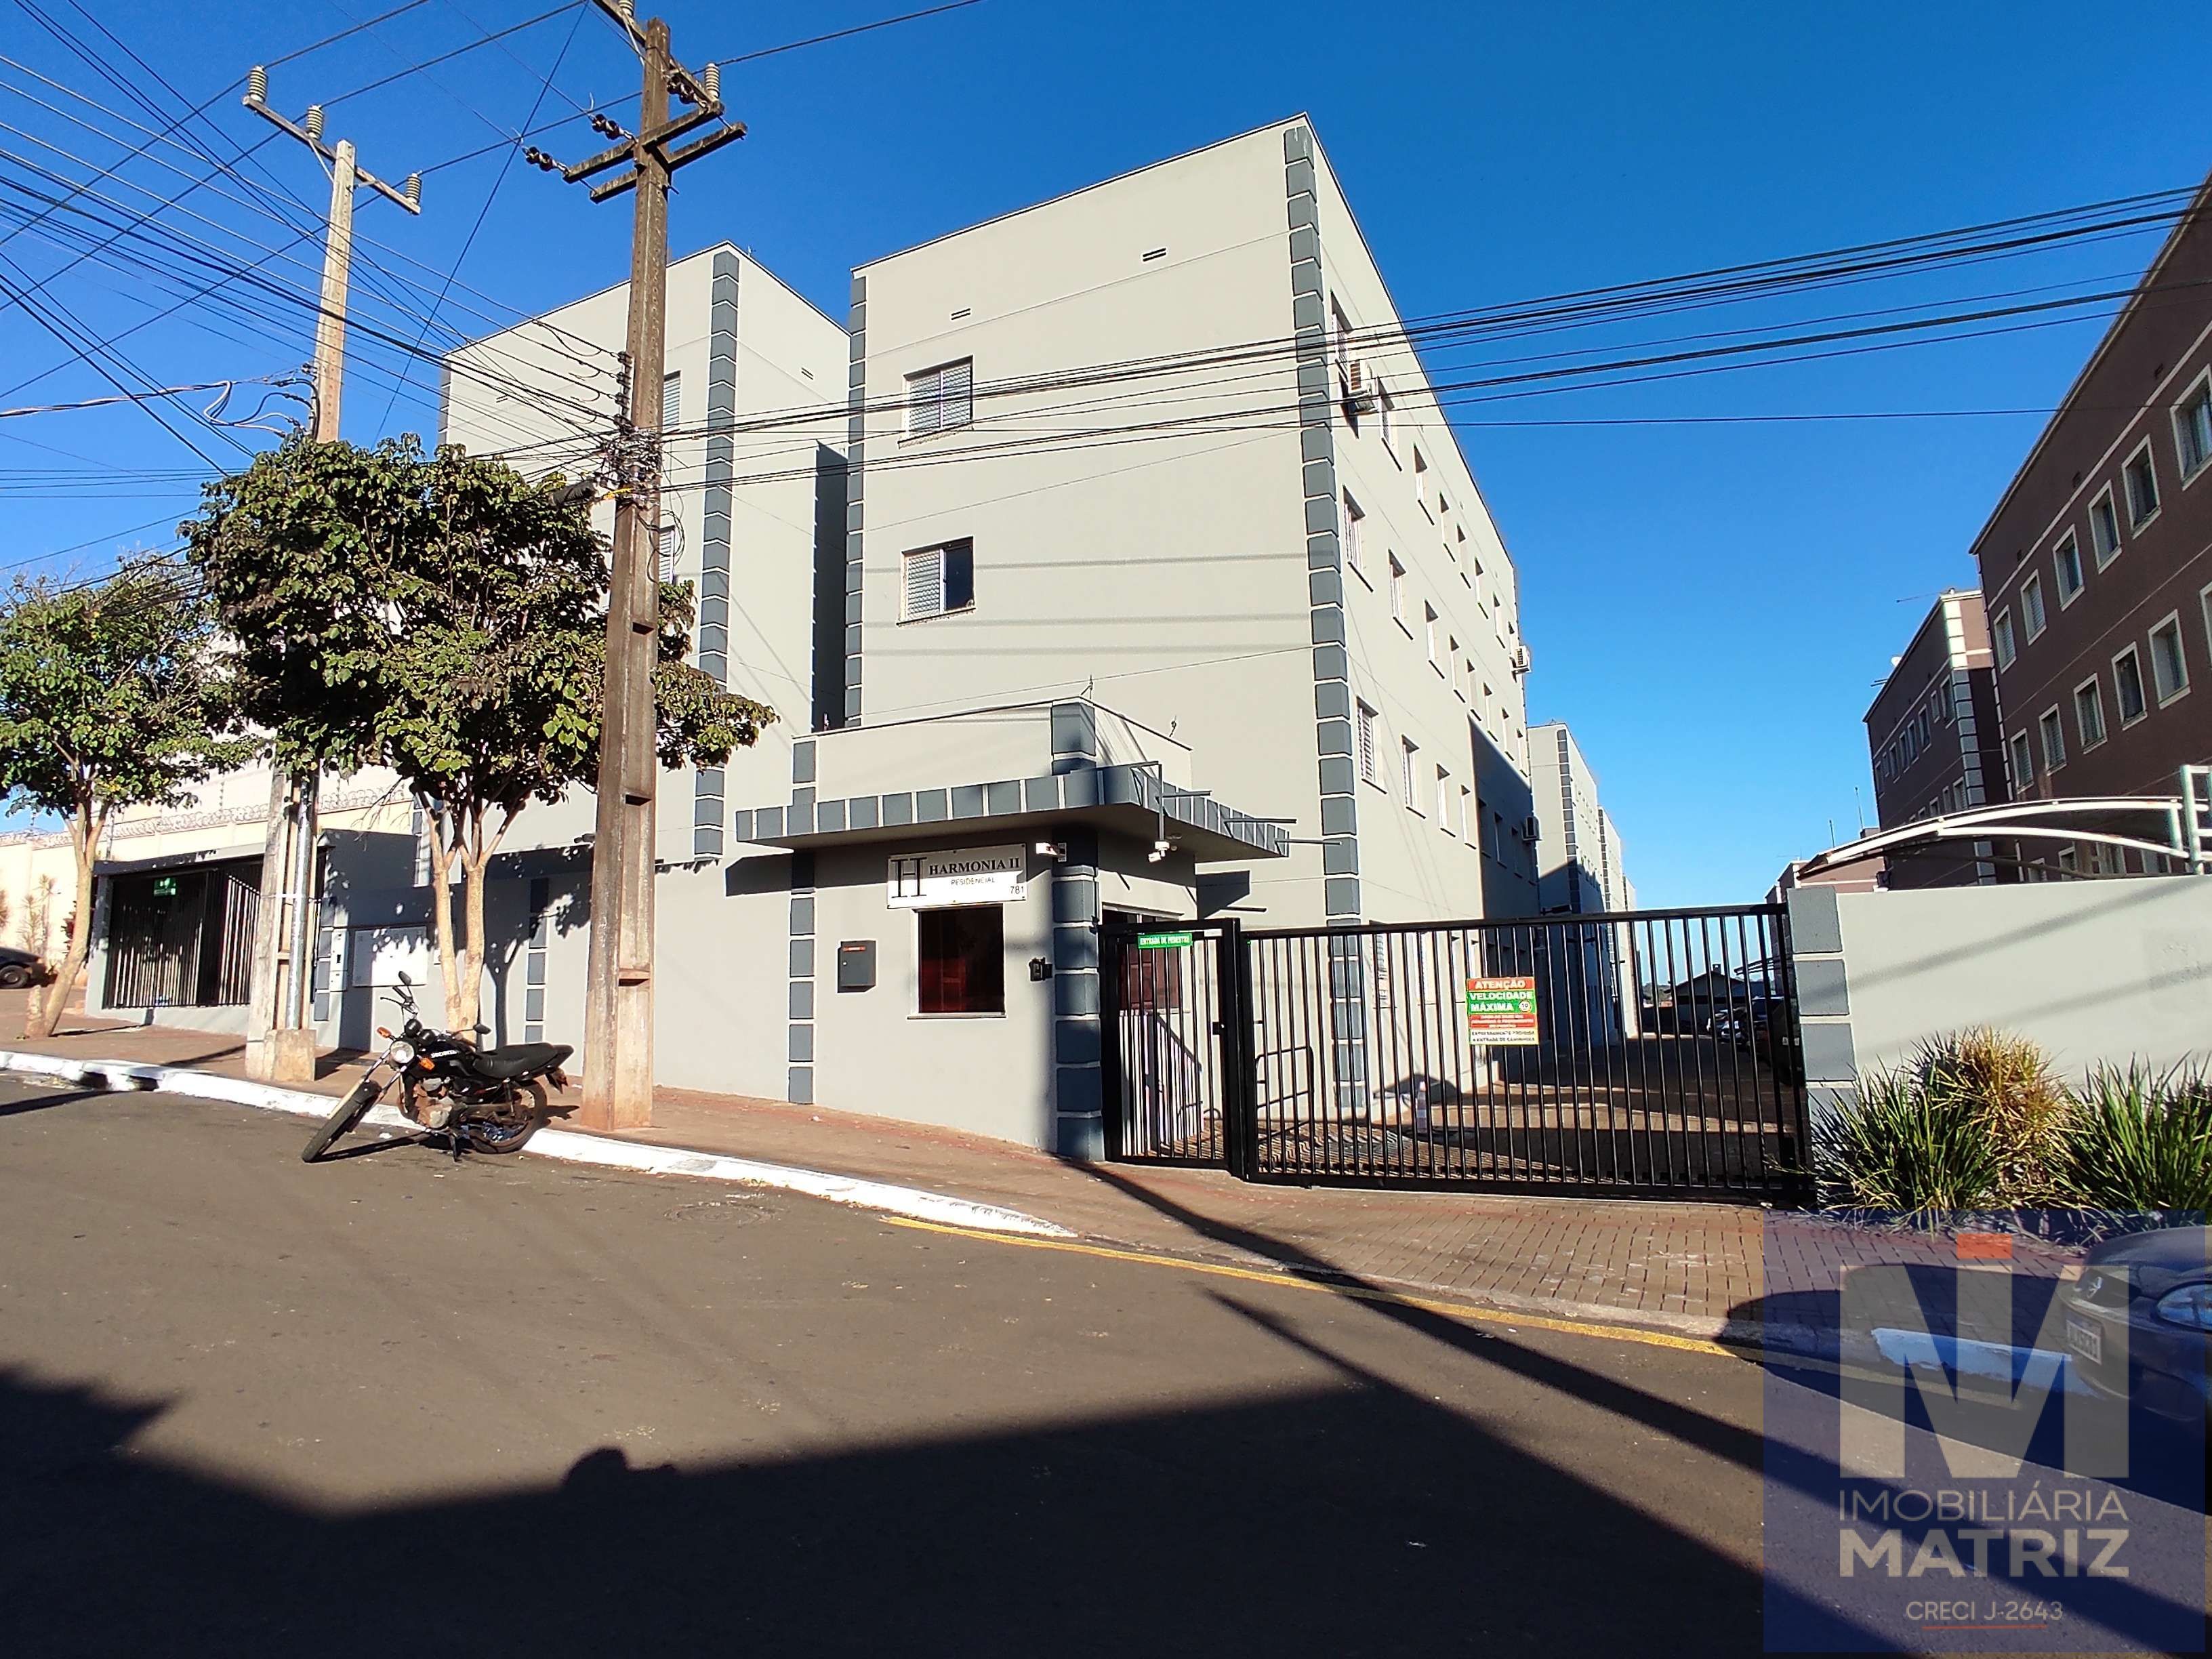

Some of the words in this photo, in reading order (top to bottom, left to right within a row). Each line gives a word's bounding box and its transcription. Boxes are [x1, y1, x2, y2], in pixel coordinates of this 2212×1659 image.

[929, 860, 1006, 875] HARMONIA
[1010, 857, 1020, 869] II
[951, 877, 996, 886] RESIDENCIAL
[1010, 885, 1024, 895] 781
[1475, 979, 1525, 989] ATENÇÃO
[1471, 1002, 1513, 1011] MÁXIMA
